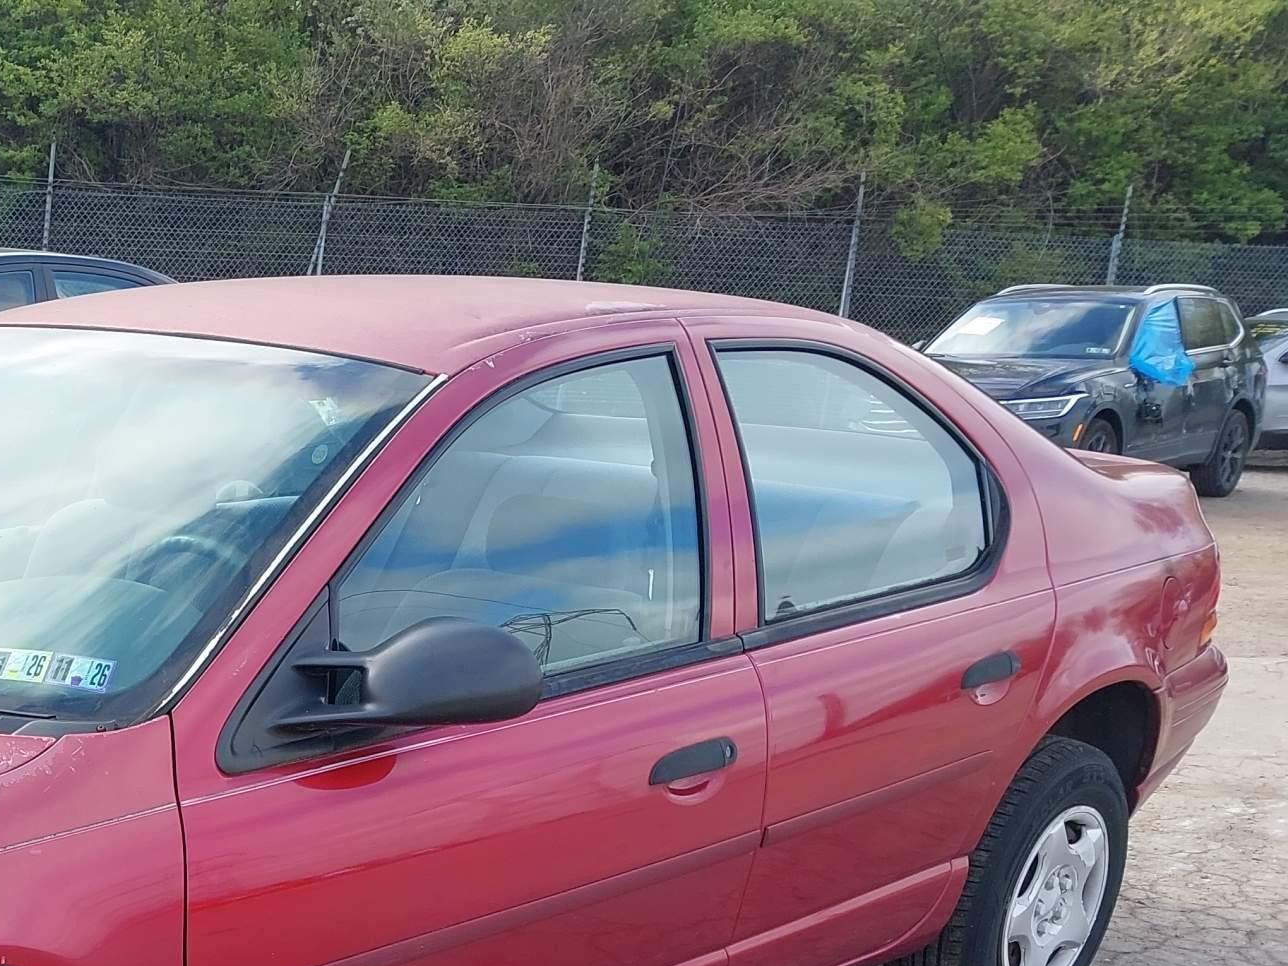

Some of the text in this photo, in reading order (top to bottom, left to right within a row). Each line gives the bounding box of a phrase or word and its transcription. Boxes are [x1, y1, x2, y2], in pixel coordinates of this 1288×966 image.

[26, 654, 47, 677] 26
[52, 655, 111, 688] 11 26
